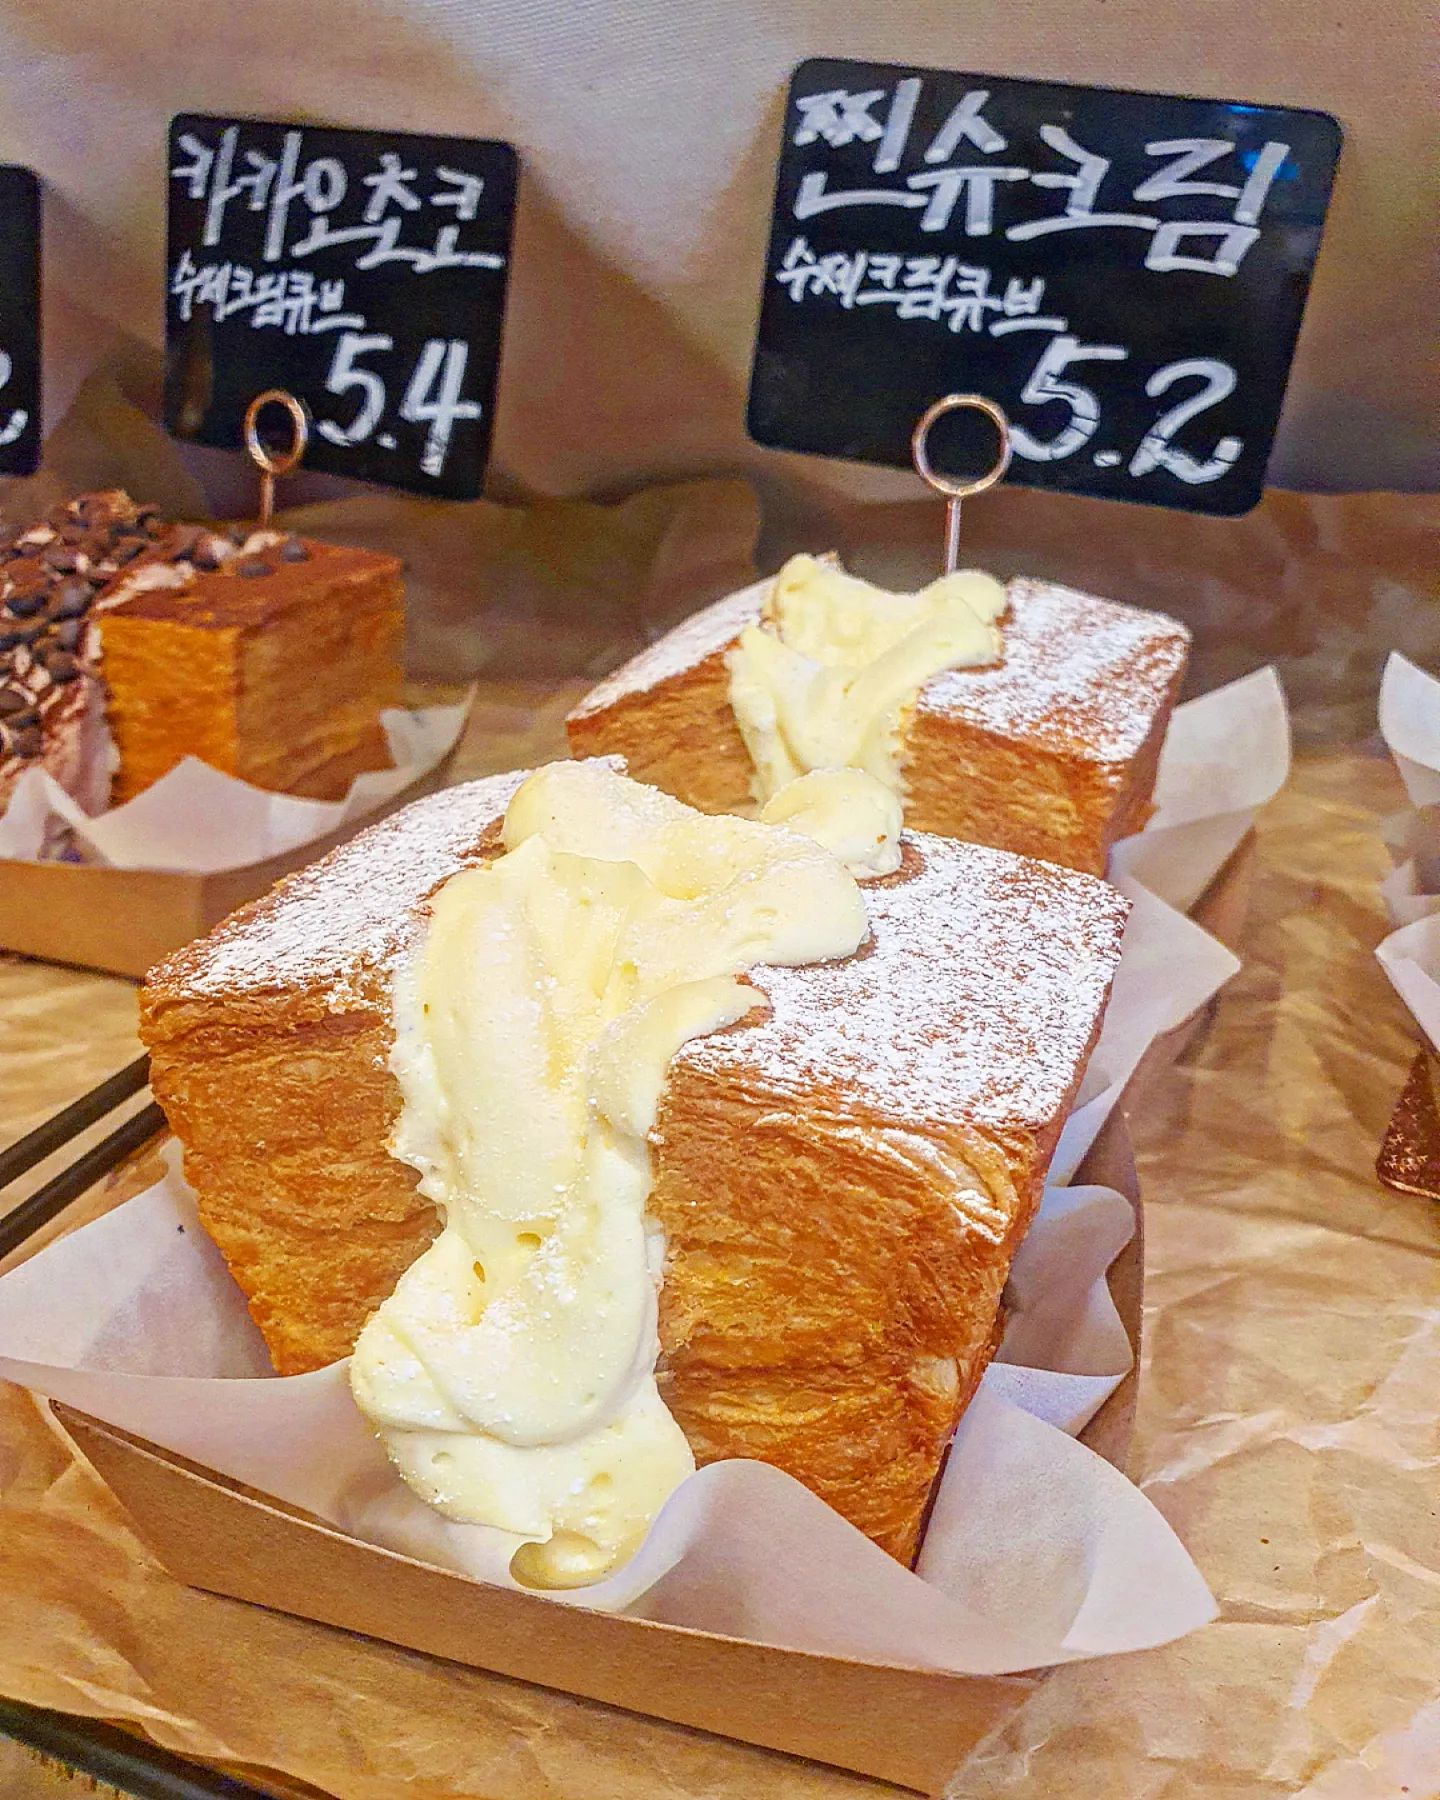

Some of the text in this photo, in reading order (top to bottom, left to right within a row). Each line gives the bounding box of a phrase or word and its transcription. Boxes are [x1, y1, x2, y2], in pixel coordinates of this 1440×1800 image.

[173, 126, 504, 272] 카카오초코
[795, 79, 1289, 276] 찐슈크림
[316, 335, 482, 476] 5.4
[1009, 337, 1242, 483] 5.2
